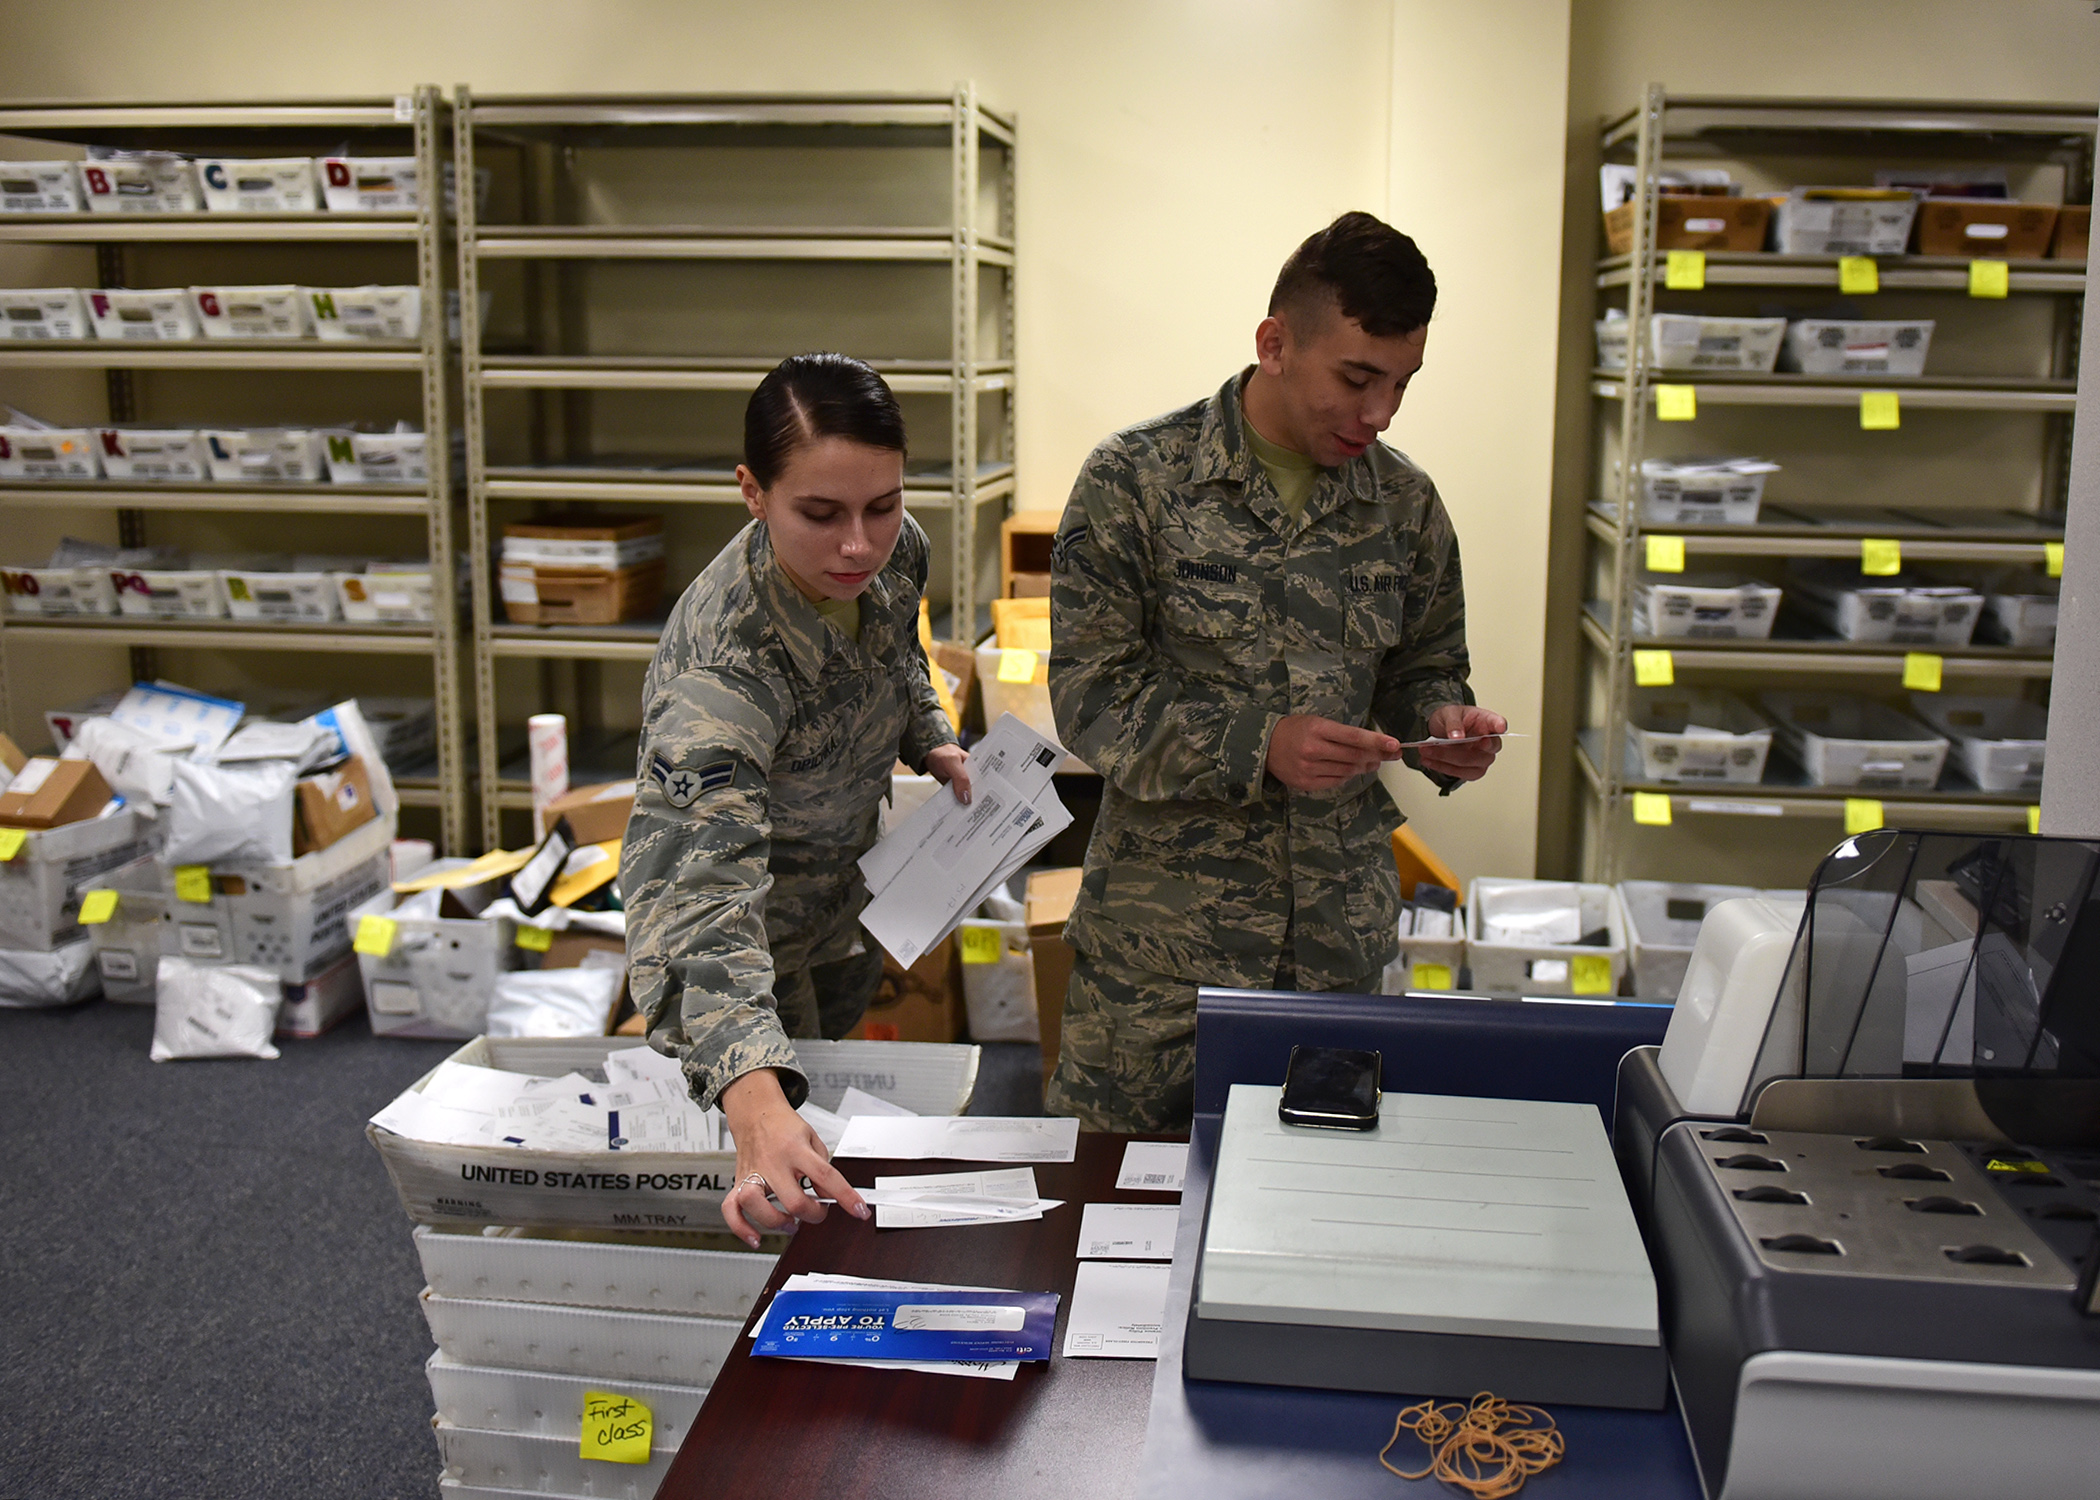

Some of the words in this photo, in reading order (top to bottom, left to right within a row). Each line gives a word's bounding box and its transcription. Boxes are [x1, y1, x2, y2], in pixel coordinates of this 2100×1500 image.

[86, 168, 110, 194] B
[205, 164, 227, 189] C
[327, 162, 350, 188] D
[102, 430, 125, 457] K
[209, 436, 234, 460] L
[1173, 561, 1237, 583] JOHNSON
[1349, 575, 1372, 593] U.S.
[1373, 573, 1392, 593] AIR
[52, 717, 72, 741] T
[461, 1163, 539, 1186] UNITED
[544, 1172, 630, 1190] STATES
[636, 1173, 726, 1191] POSTAL
[613, 1213, 640, 1225] MM
[645, 1214, 687, 1226] TRAY
[785, 1316, 853, 1326] APPLY
[859, 1316, 885, 1325] TO
[1016, 1347, 1033, 1355] citi
[588, 1398, 635, 1421] First
[598, 1420, 647, 1446] class
